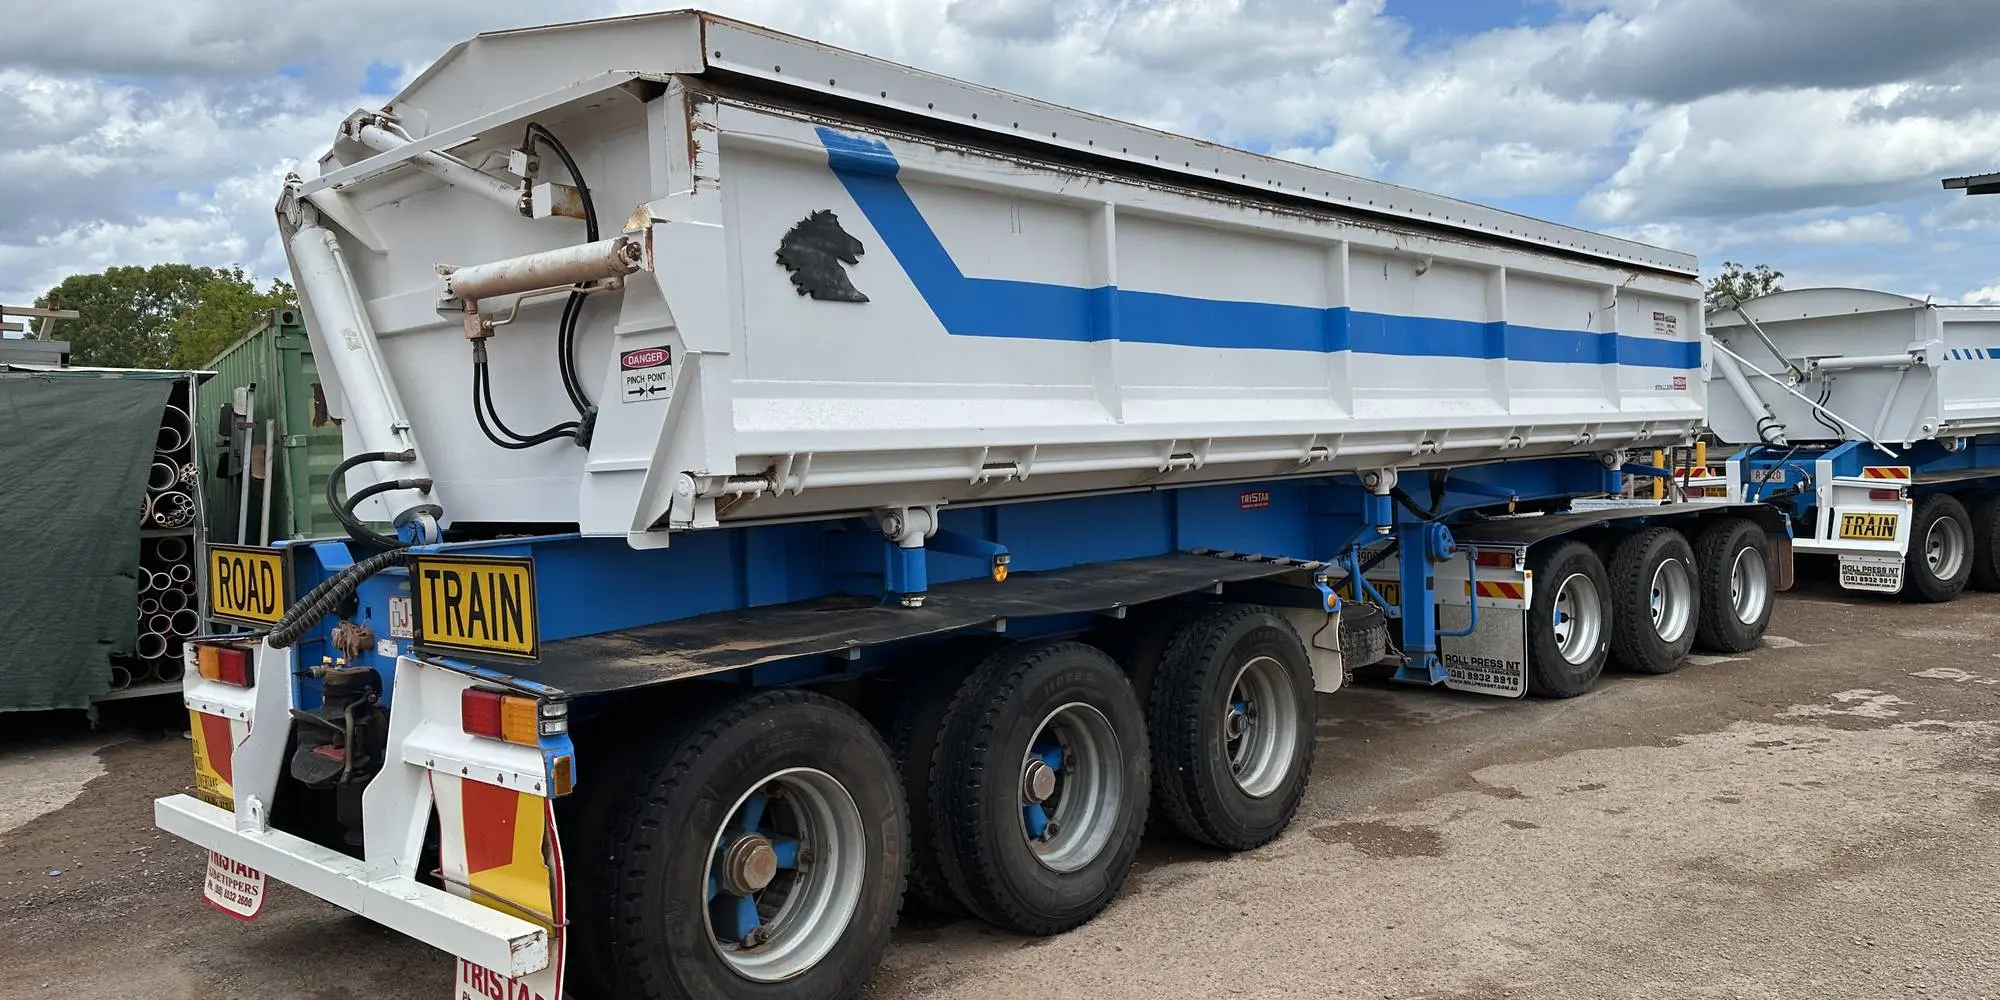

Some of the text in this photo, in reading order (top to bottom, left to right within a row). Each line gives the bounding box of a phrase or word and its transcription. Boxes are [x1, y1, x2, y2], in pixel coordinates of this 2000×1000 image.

[628, 352, 663, 365] DANGER
[626, 372, 666, 384] PINCH POINT
[1241, 493, 1269, 504] TRISTAR
[1844, 516, 1895, 537] TRAIN
[1842, 564, 1860, 572] ROLL
[1862, 566, 1887, 574] PRESS
[218, 556, 275, 614] ROAD
[425, 570, 524, 644] TRAIN
[1445, 654, 1520, 670] ROLL PRESS NT
[1467, 672, 1491, 682] 8932
[1493, 675, 1519, 685] 9916
[208, 866, 259, 896] SIDETIPPERS
